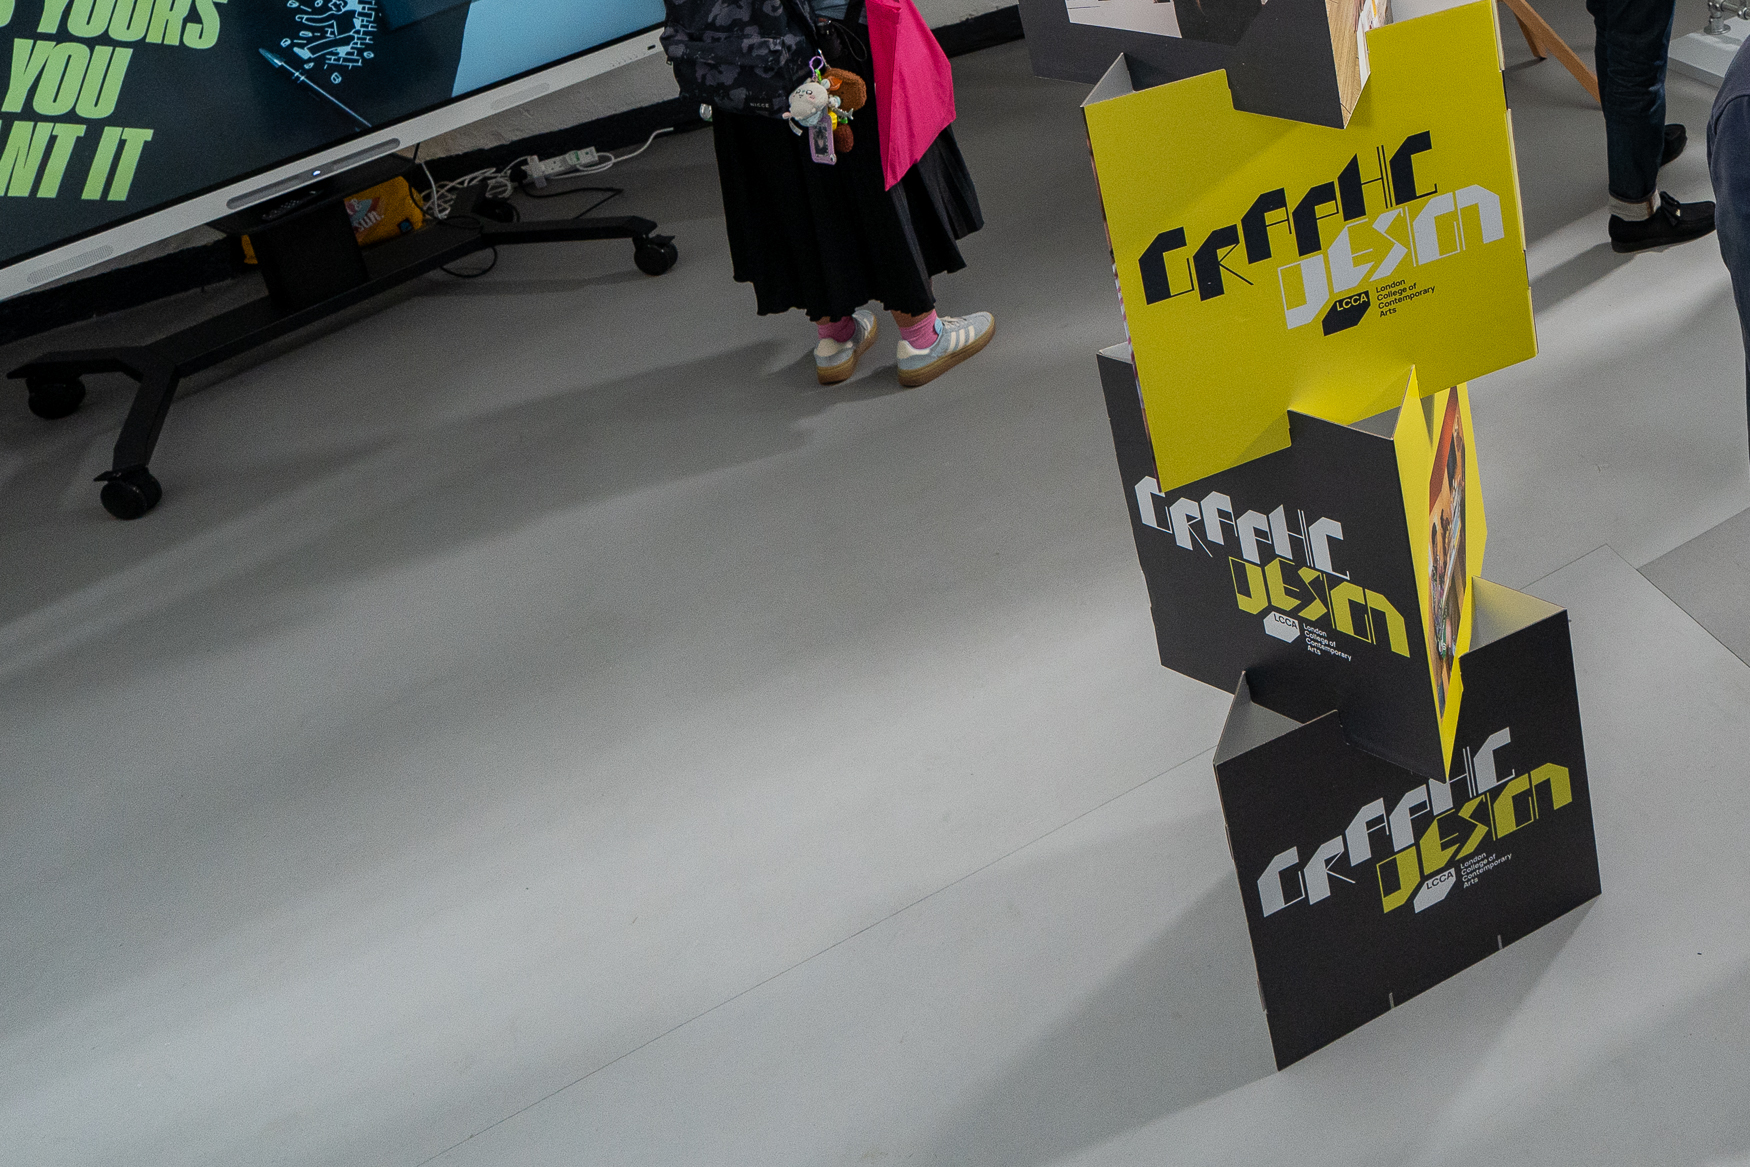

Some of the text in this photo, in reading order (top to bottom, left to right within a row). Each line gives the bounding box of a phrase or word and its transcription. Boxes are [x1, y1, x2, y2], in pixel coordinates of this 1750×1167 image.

[2, 38, 133, 119] YOU
[0, 119, 154, 201] NT IT
[1375, 279, 1405, 293] London
[1377, 282, 1417, 301] College of
[1336, 293, 1368, 311] LCCA
[1378, 286, 1435, 309] Contemporary
[1380, 307, 1397, 317] Arts
[1273, 613, 1298, 629] LCCA
[1302, 623, 1327, 637] London
[1304, 630, 1328, 645] College
[1306, 637, 1351, 661] Contemporary
[1307, 645, 1321, 656] Arts
[1460, 852, 1487, 869] London
[1461, 853, 1496, 875] College of
[1462, 853, 1512, 882] Contemporary
[1426, 871, 1454, 890] LCCA
[1463, 877, 1478, 889] Arts
